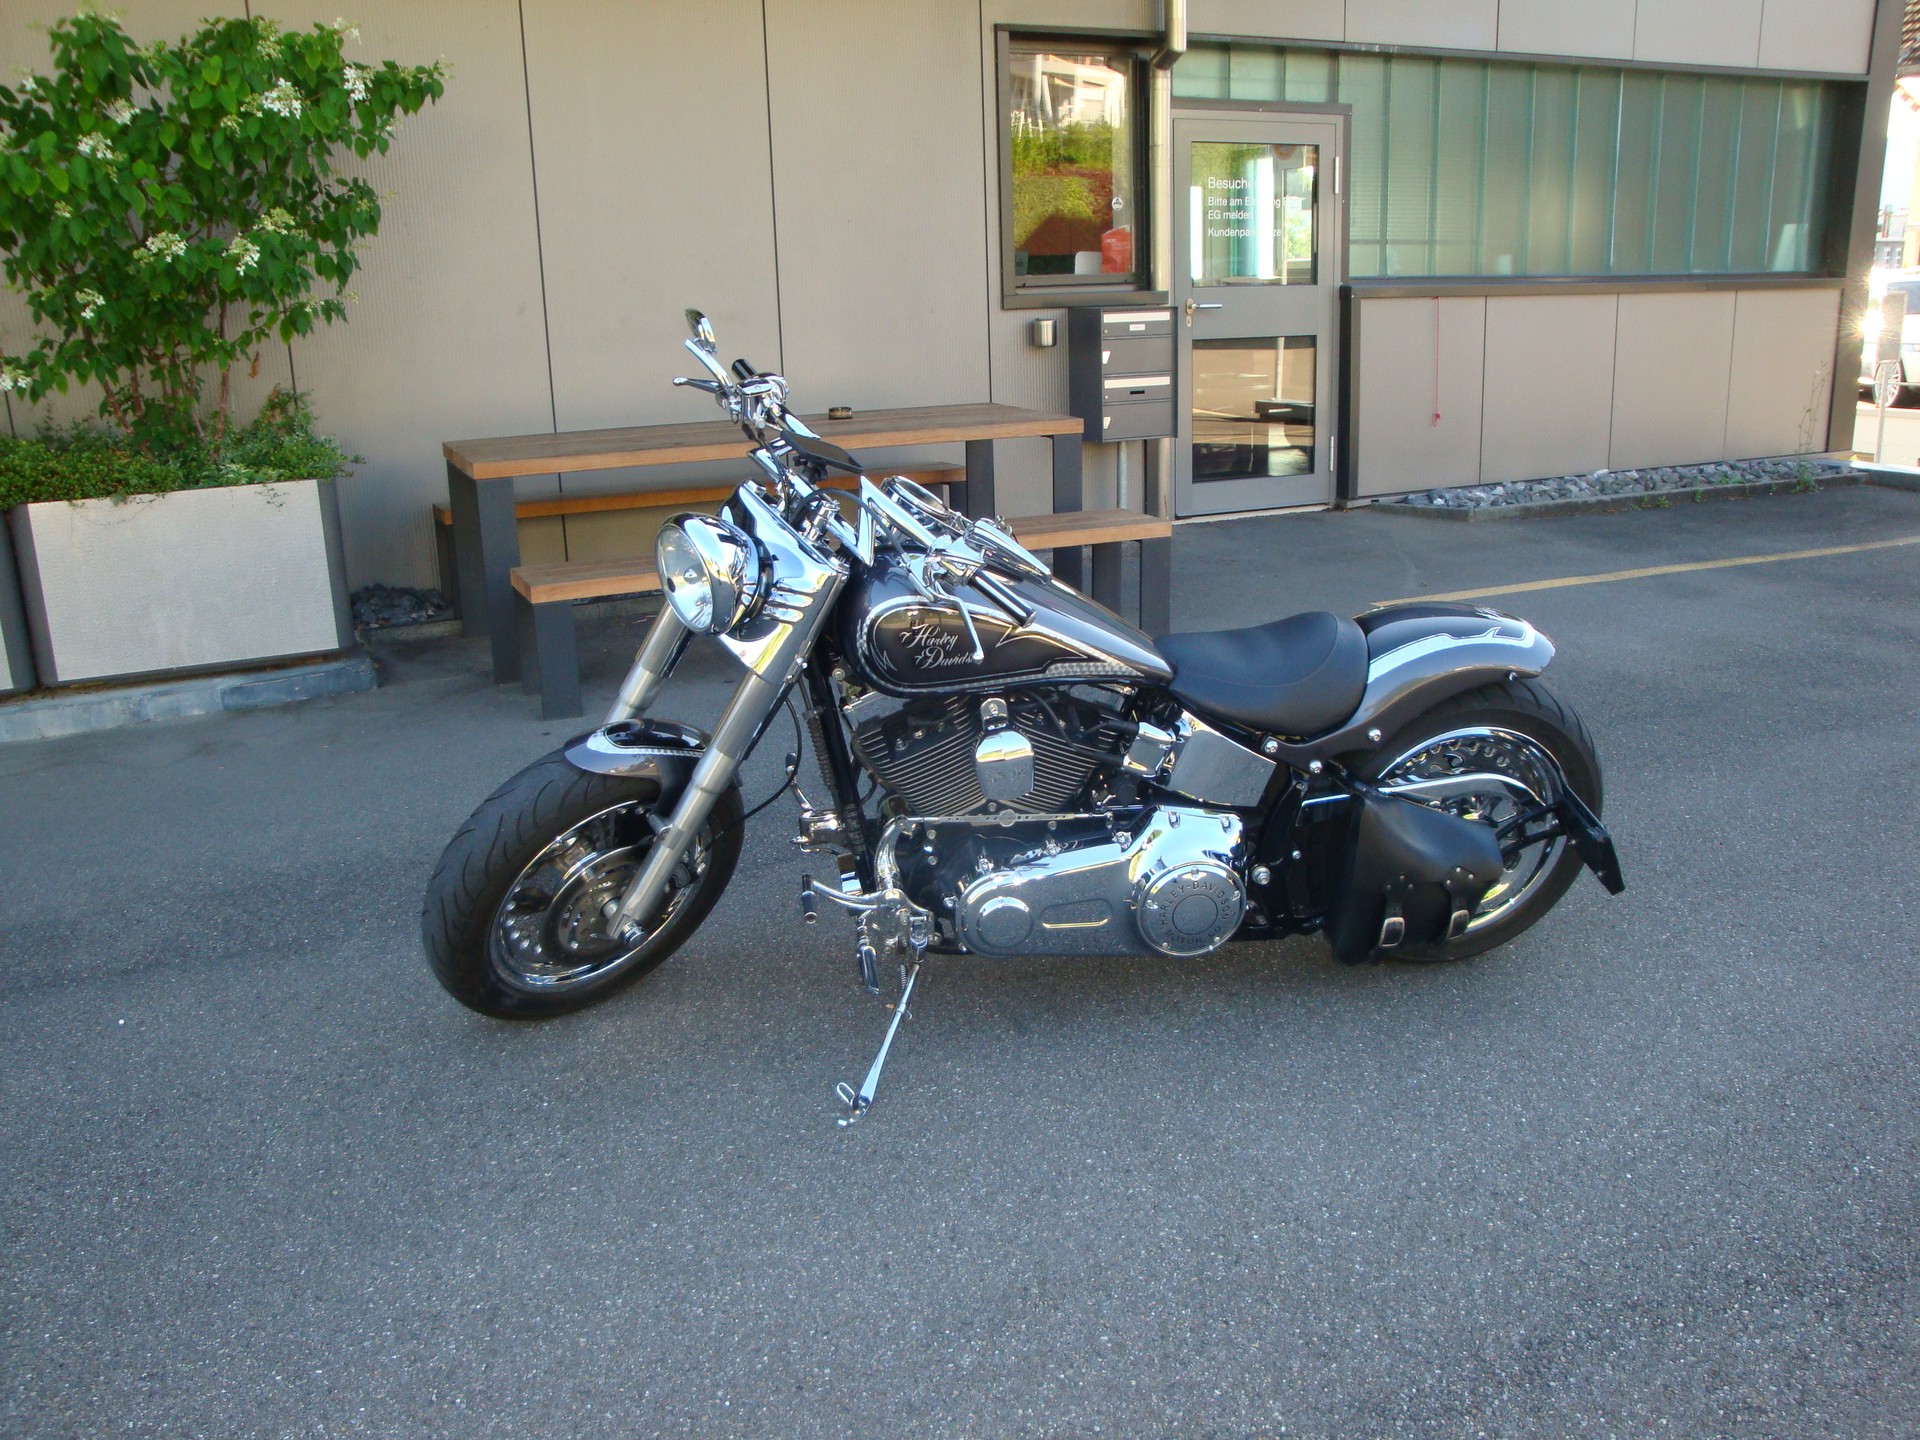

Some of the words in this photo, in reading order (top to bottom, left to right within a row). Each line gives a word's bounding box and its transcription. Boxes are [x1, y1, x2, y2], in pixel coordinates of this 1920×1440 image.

[1207, 197, 1228, 206] Bitte
[1229, 198, 1243, 206] am
[1207, 210, 1221, 220] EG
[899, 623, 959, 651] Harley
[914, 645, 974, 670] Davids
